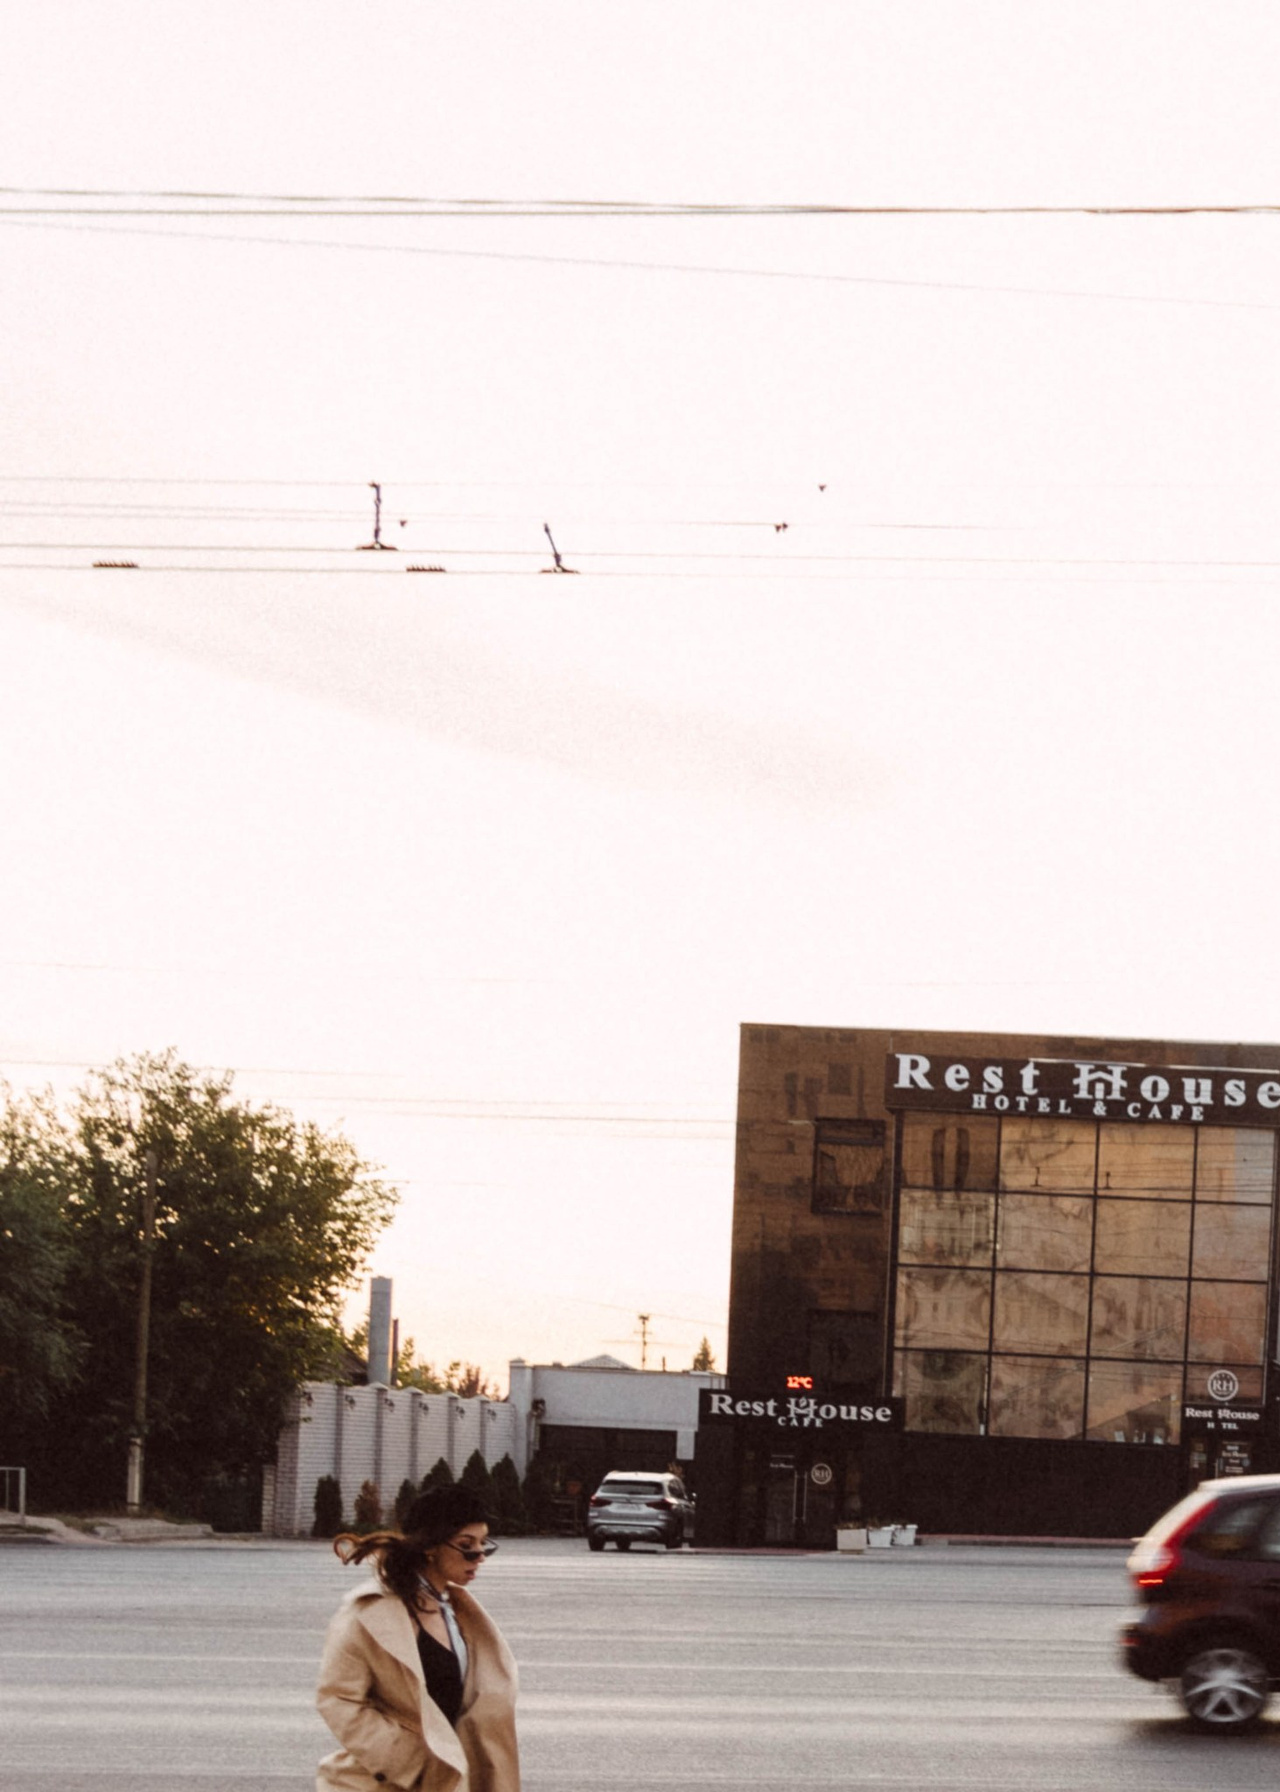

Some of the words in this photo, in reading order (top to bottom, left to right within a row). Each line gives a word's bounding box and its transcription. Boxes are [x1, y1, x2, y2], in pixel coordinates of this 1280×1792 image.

[894, 1053, 1040, 1095] Rest
[972, 1094, 1071, 1114] HOTEL
[1093, 1101, 1107, 1117] &
[1127, 1102, 1205, 1121] CAFE
[1212, 1380, 1234, 1391] RH
[709, 1393, 778, 1417] Rest
[786, 1397, 892, 1422] House
[1185, 1407, 1213, 1418] Rest
[1217, 1408, 1260, 1420] House
[777, 1417, 824, 1428] CAFE
